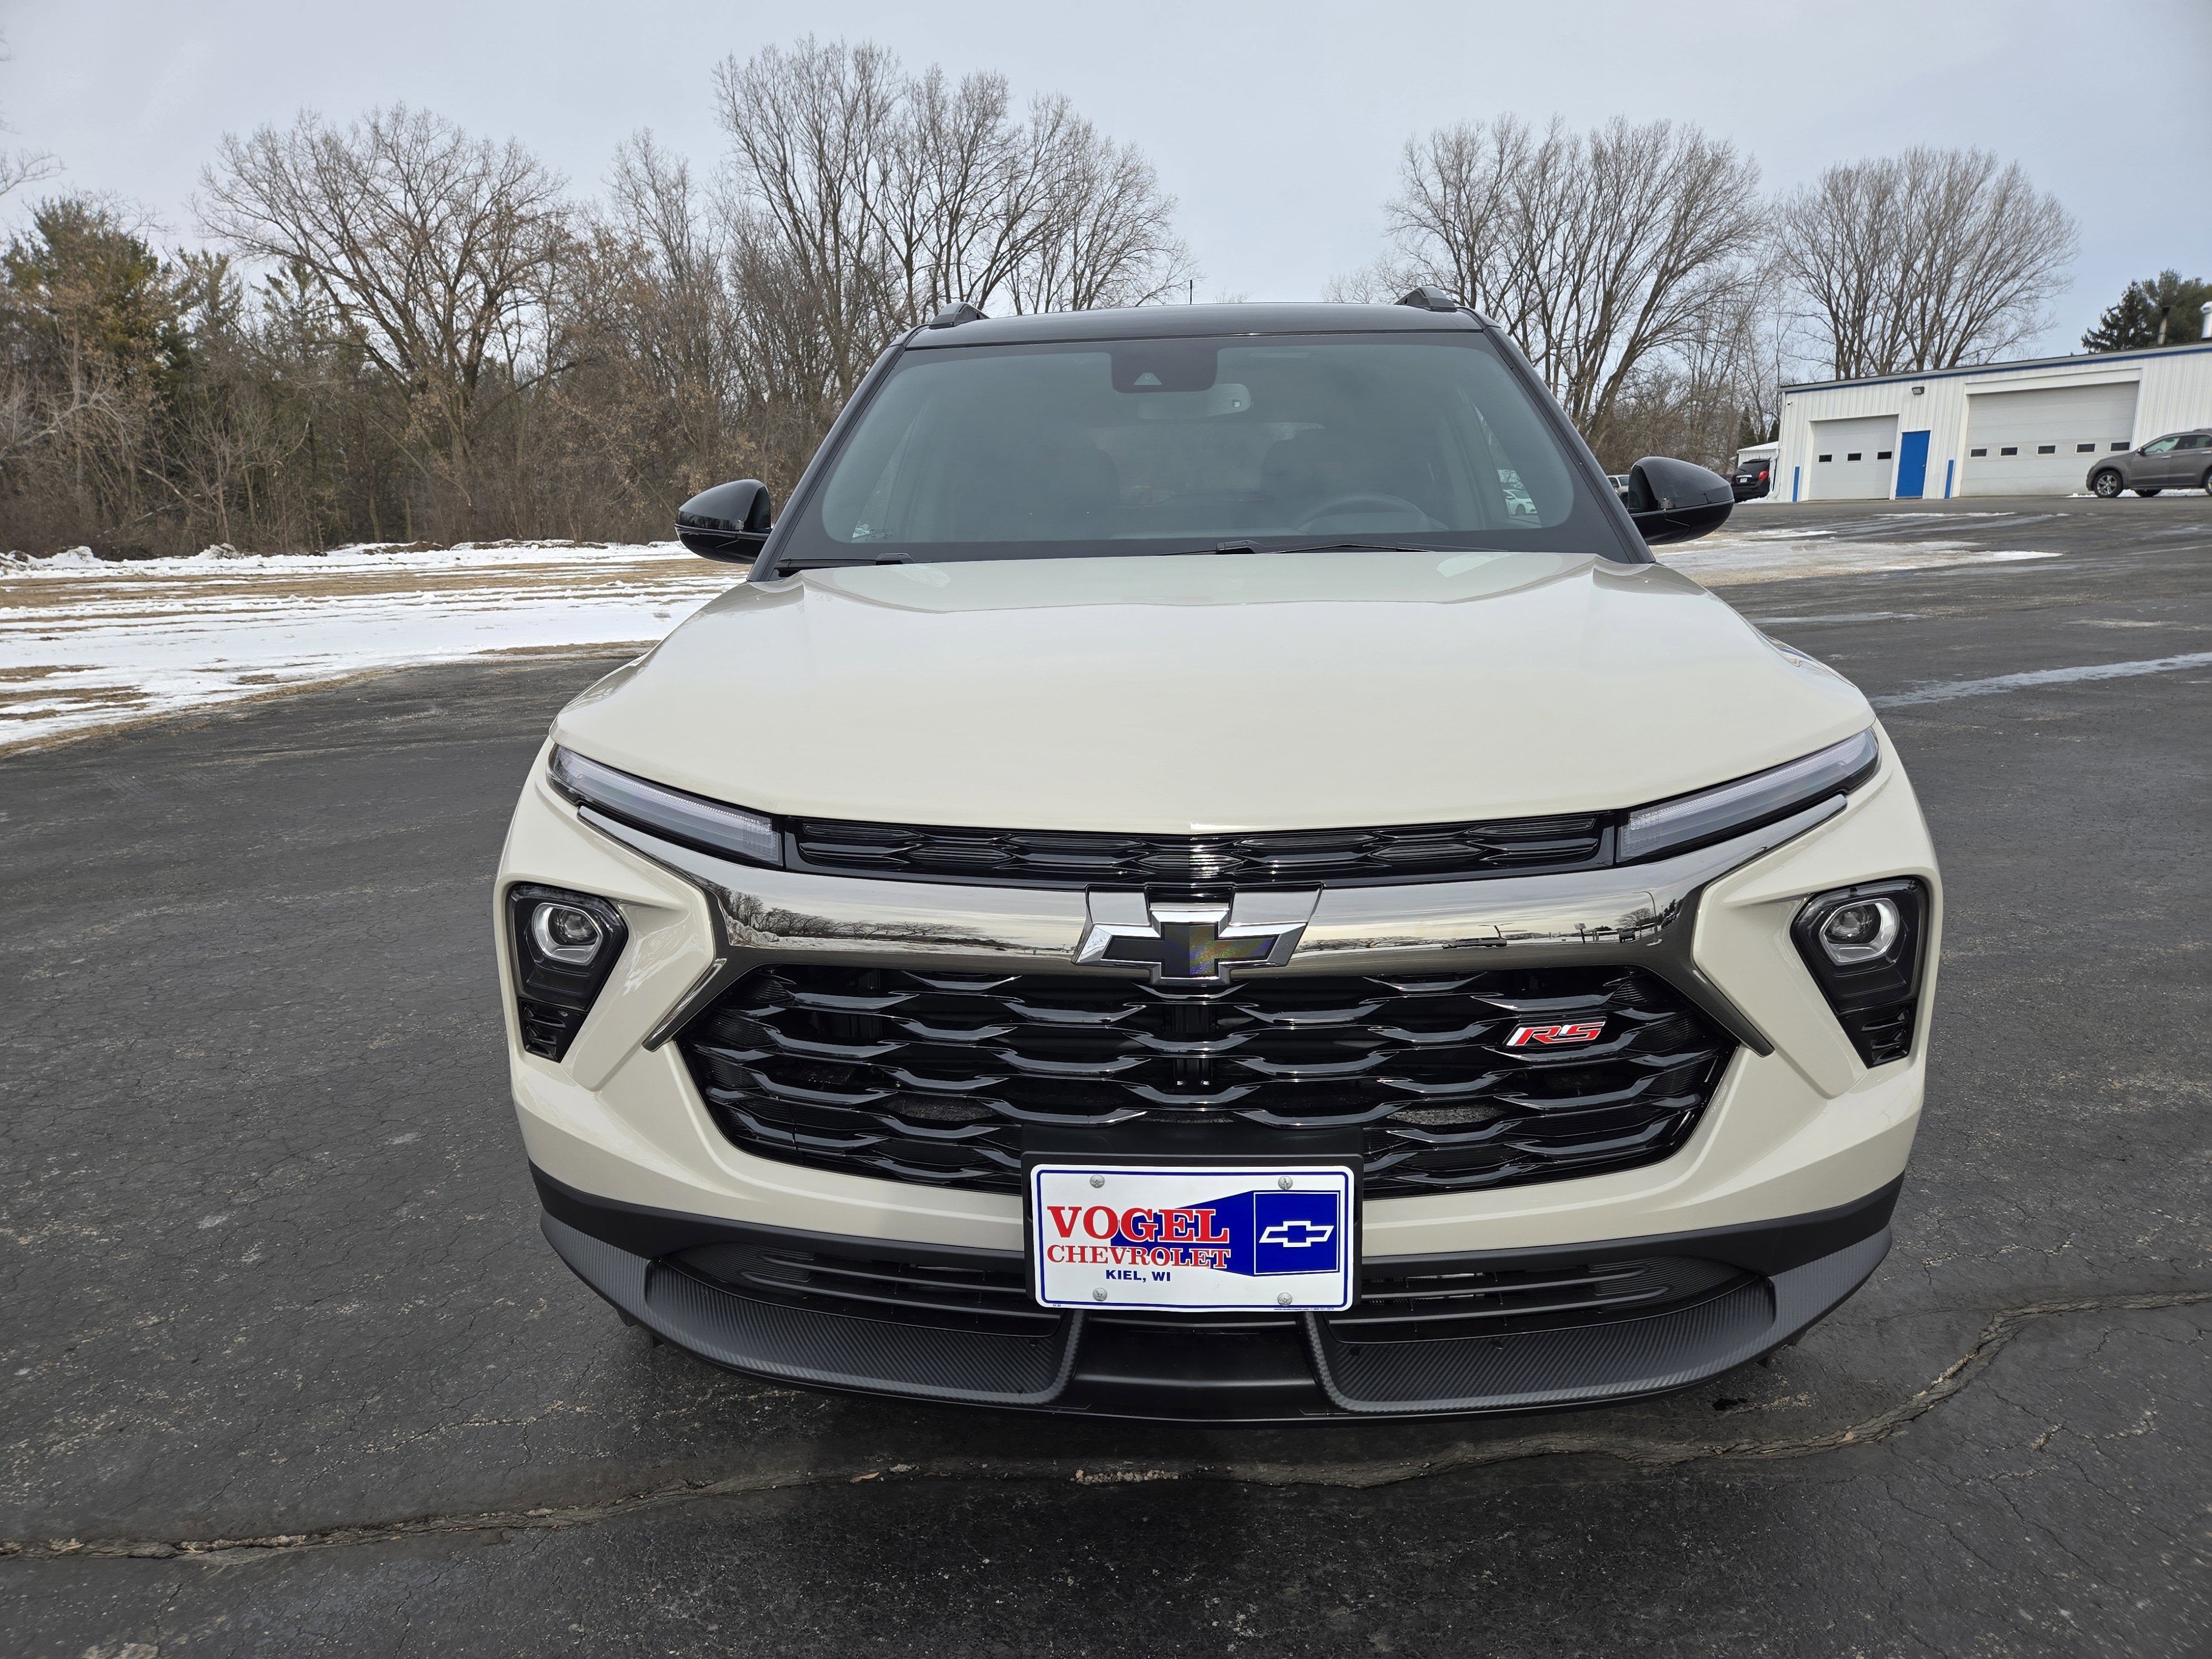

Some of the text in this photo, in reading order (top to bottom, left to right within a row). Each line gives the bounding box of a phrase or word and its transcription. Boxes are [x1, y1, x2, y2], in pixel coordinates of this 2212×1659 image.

[1506, 1021, 1606, 1046] RS
[1047, 1206, 1229, 1243] VOGEL
[1047, 1244, 1231, 1268] CHEVROLET
[1106, 1270, 1171, 1283] KIEL, WI
